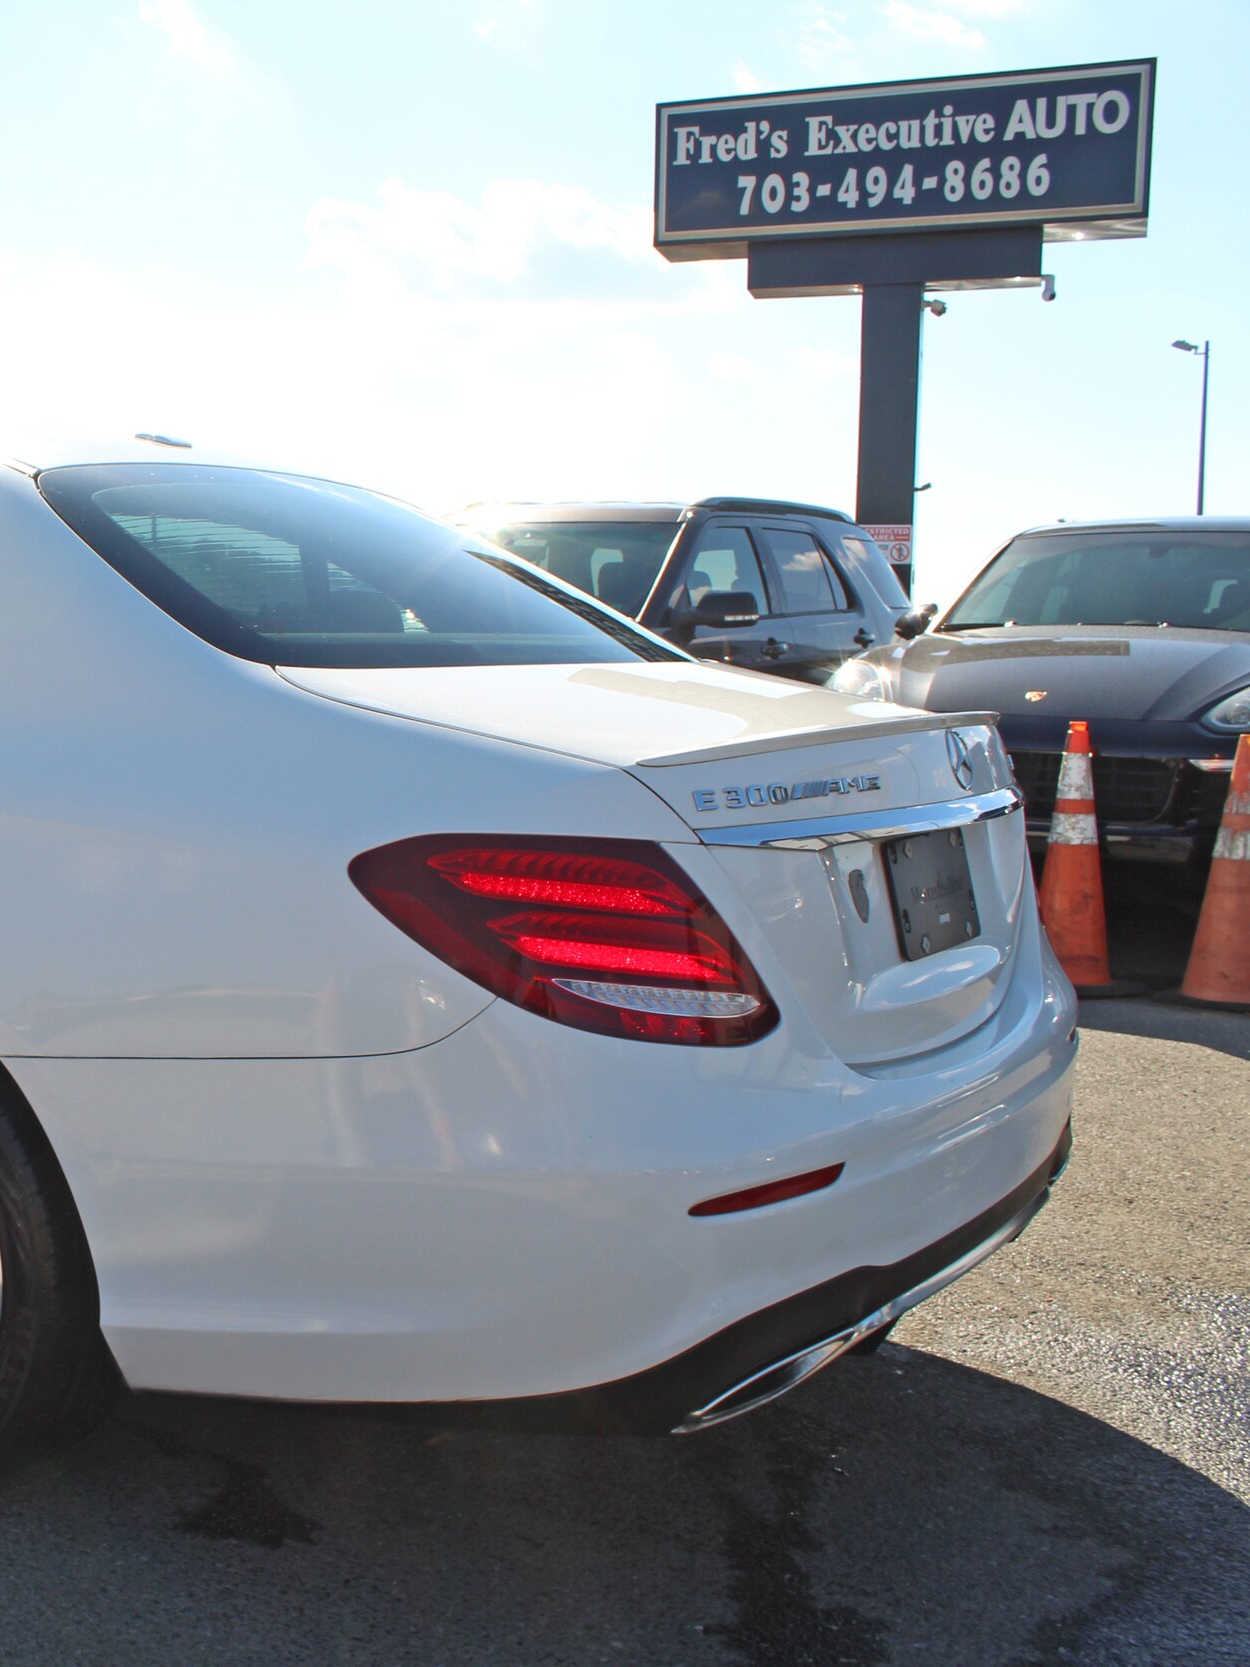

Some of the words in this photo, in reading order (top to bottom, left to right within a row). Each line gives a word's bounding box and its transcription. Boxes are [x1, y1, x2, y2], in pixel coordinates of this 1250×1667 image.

[672, 120, 788, 166] Fred's
[804, 105, 996, 157] Executive
[1003, 89, 1131, 142] AUTO
[736, 153, 1051, 216] 703-494-8686
[693, 789, 719, 811] E
[723, 782, 790, 808] 300
